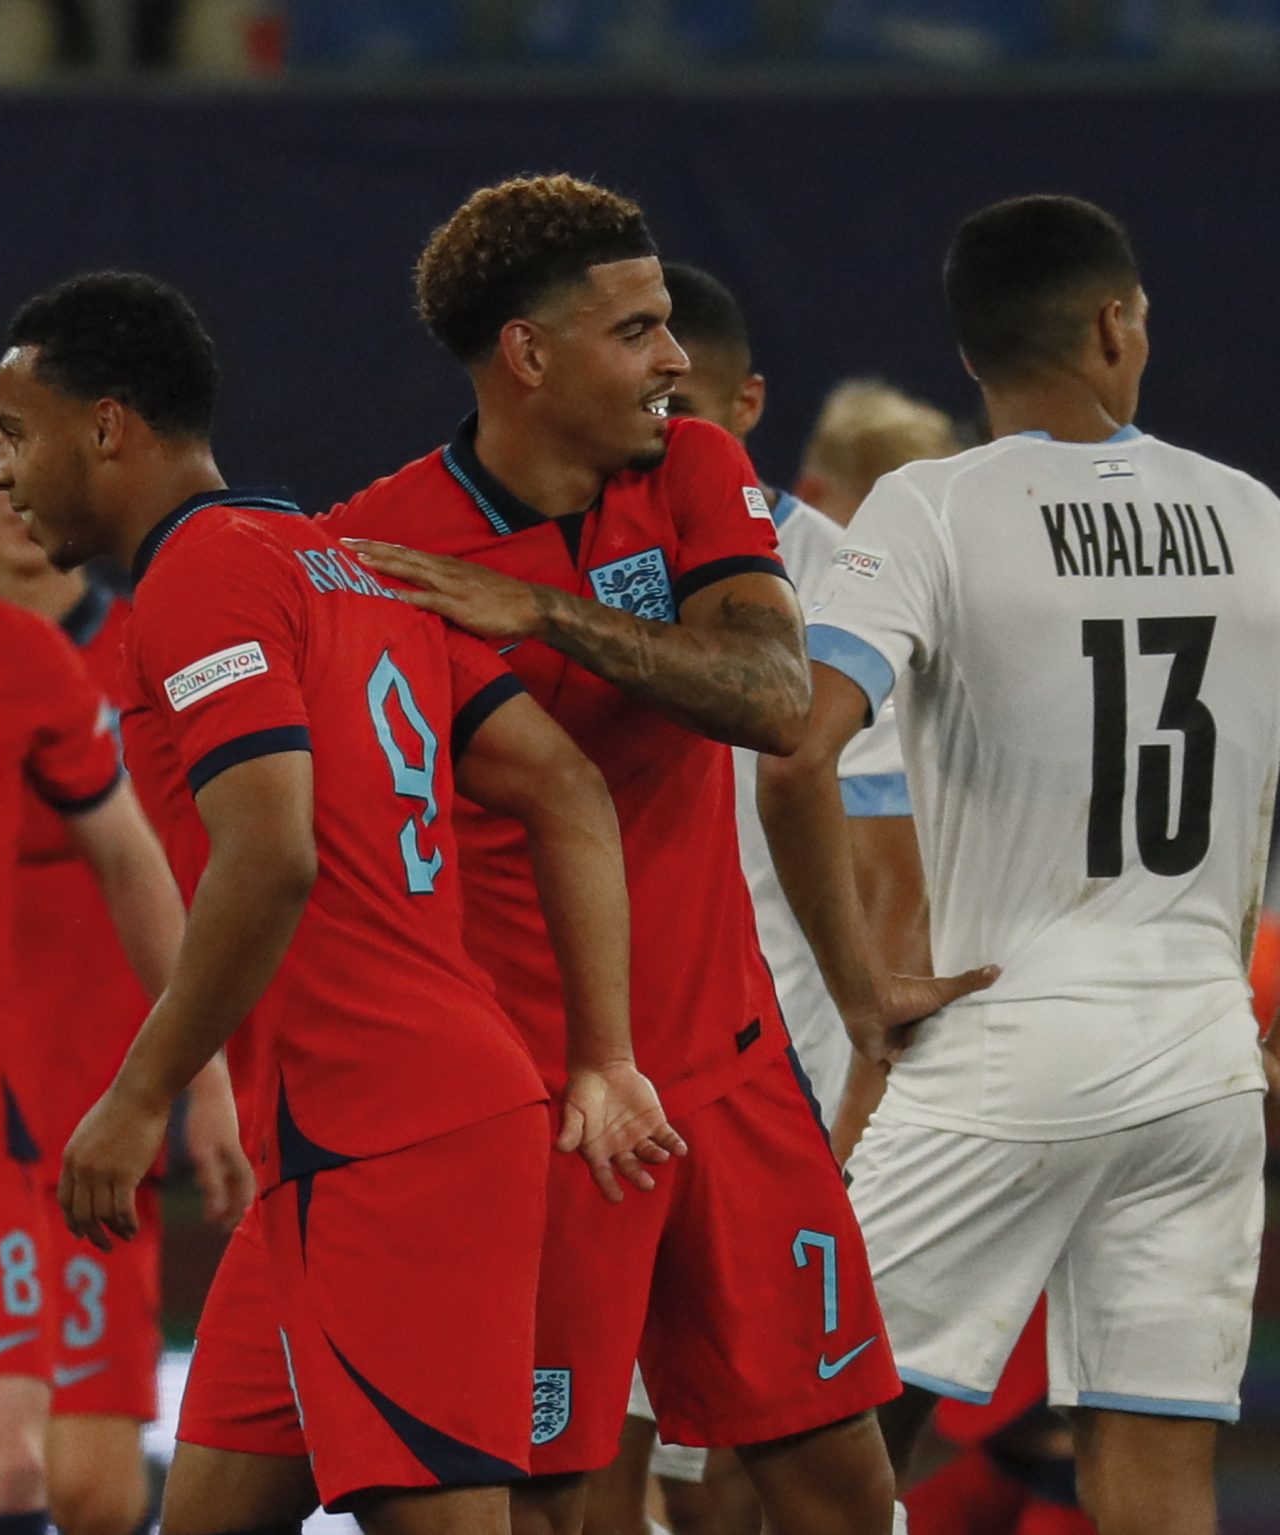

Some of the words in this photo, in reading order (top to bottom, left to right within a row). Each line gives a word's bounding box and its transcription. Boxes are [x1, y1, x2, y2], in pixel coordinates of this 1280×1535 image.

[293, 547, 400, 600] ARCH
[1040, 502, 1235, 578] KHALAILI
[170, 651, 261, 700] FOUNDATION
[366, 647, 444, 895] 9
[1081, 615, 1217, 878] 13
[63, 1255, 107, 1350] 3
[791, 1228, 838, 1335] 7
